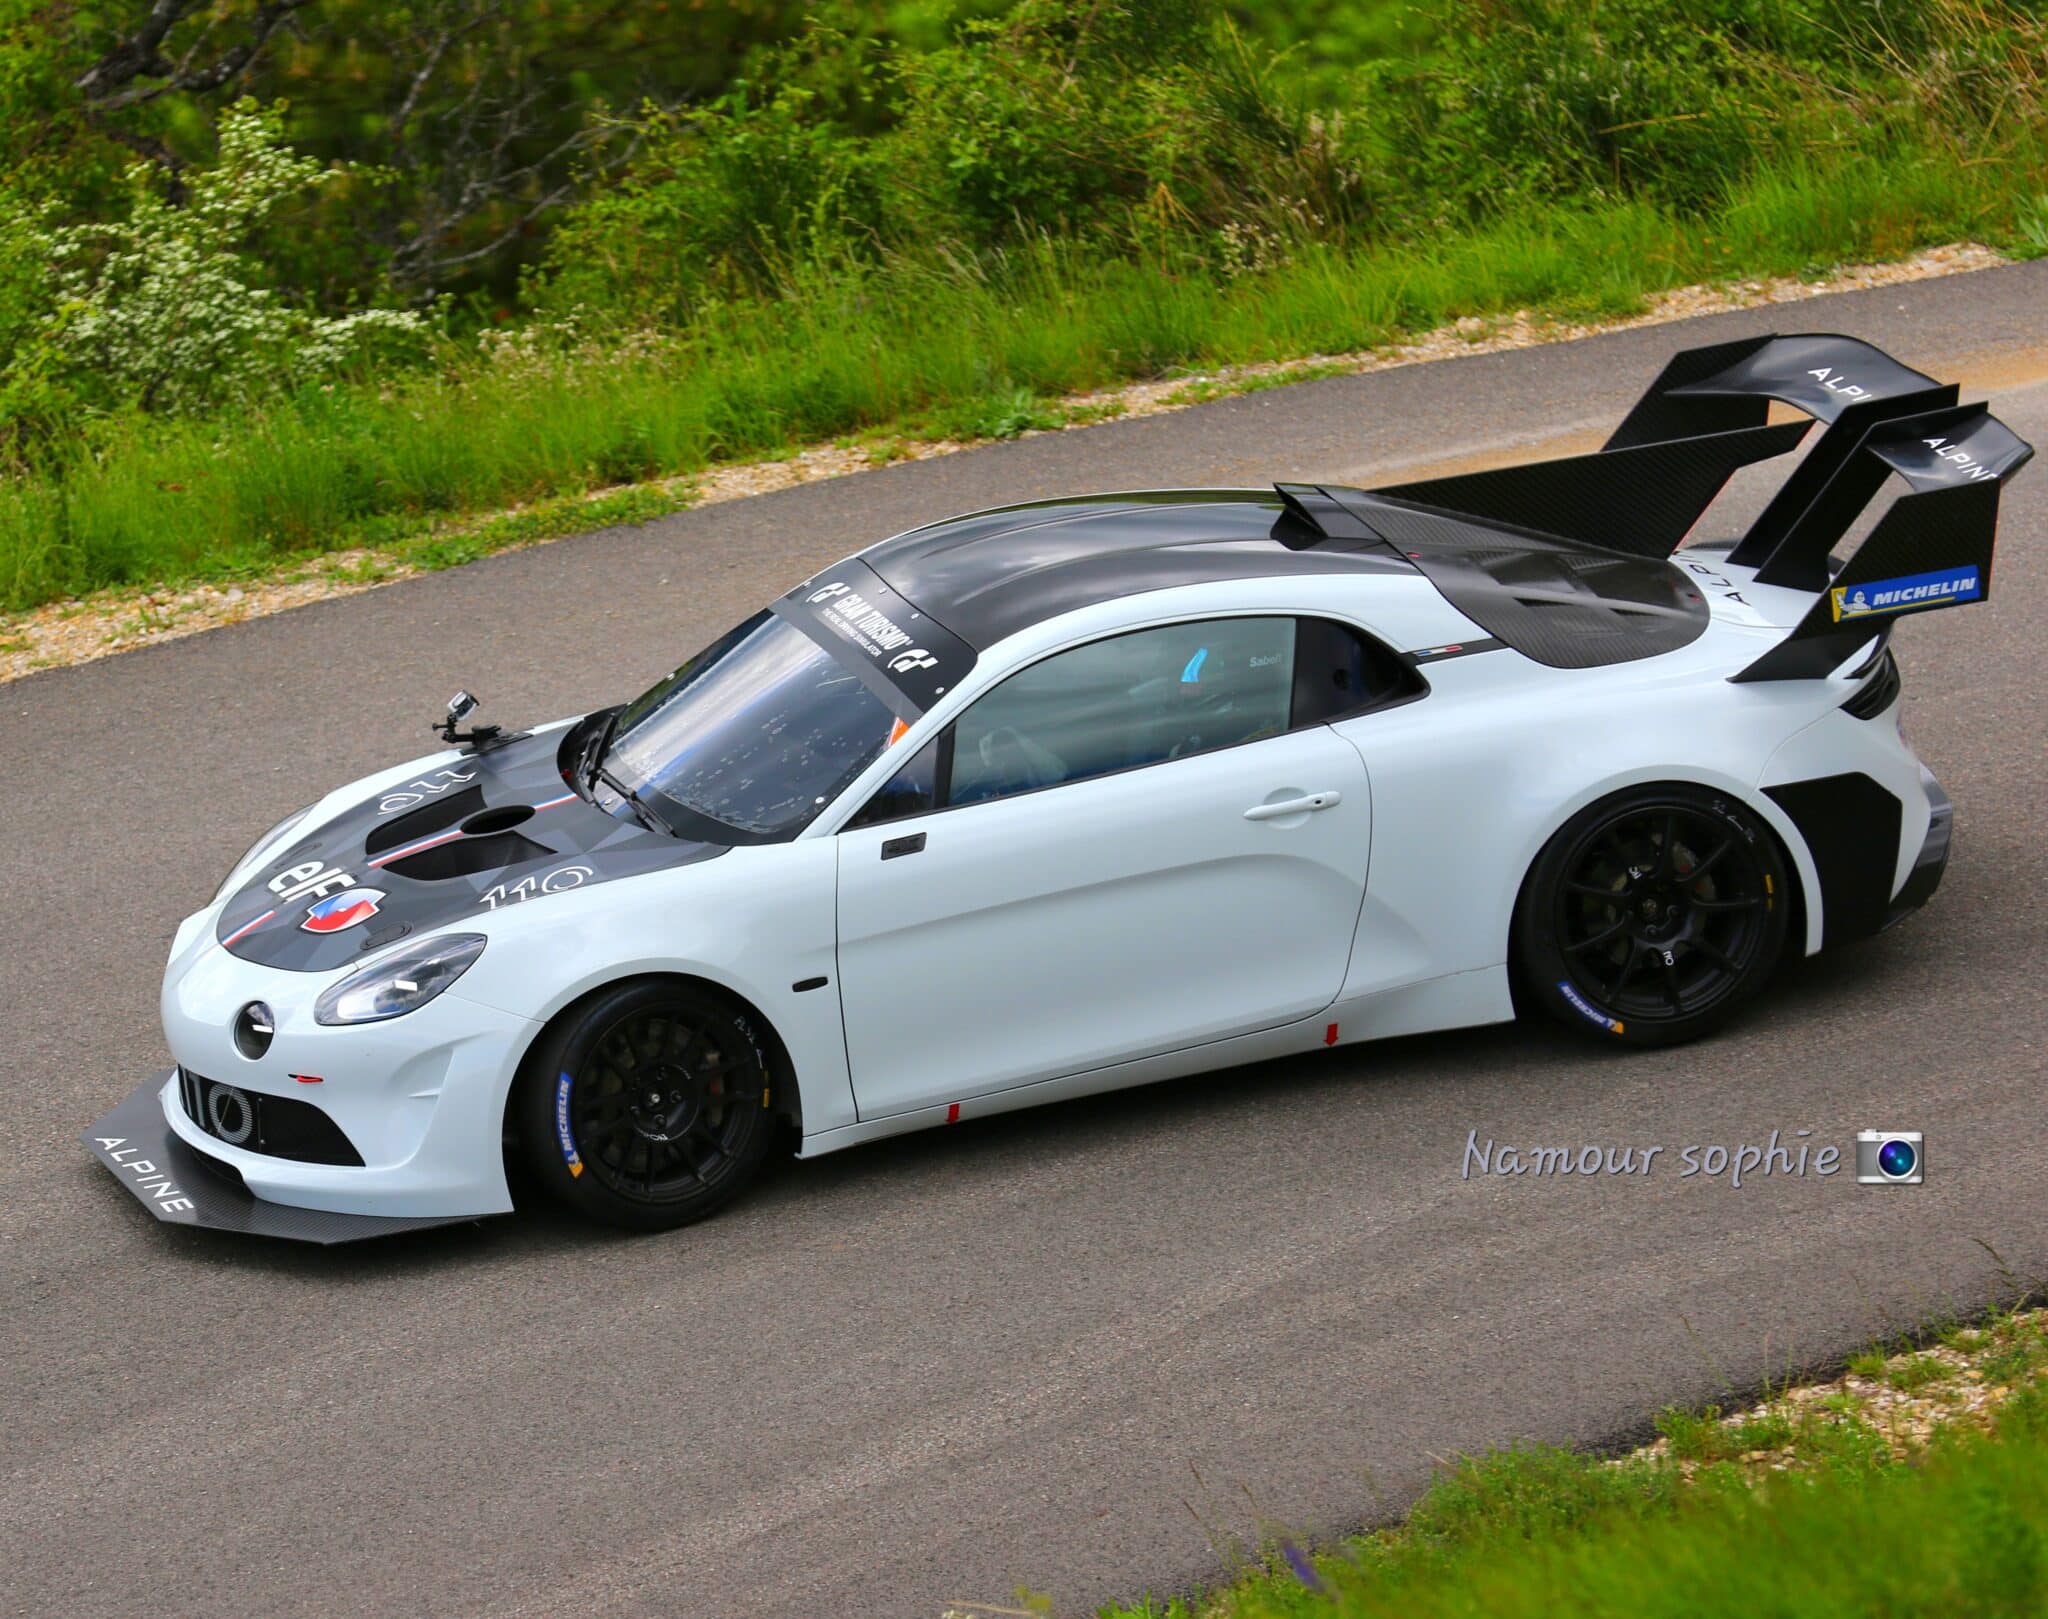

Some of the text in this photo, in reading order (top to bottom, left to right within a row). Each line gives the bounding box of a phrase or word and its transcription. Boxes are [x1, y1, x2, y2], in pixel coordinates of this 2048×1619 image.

[1808, 367, 1872, 402] ALPI
[1872, 577, 1976, 606] MICHELIN
[832, 594, 874, 620] GRAN
[855, 609, 911, 650] TURISMO
[267, 861, 358, 904] elf
[479, 865, 594, 910] 110
[559, 1080, 573, 1151] MICHELIN
[95, 1137, 195, 1213] ALPINE
